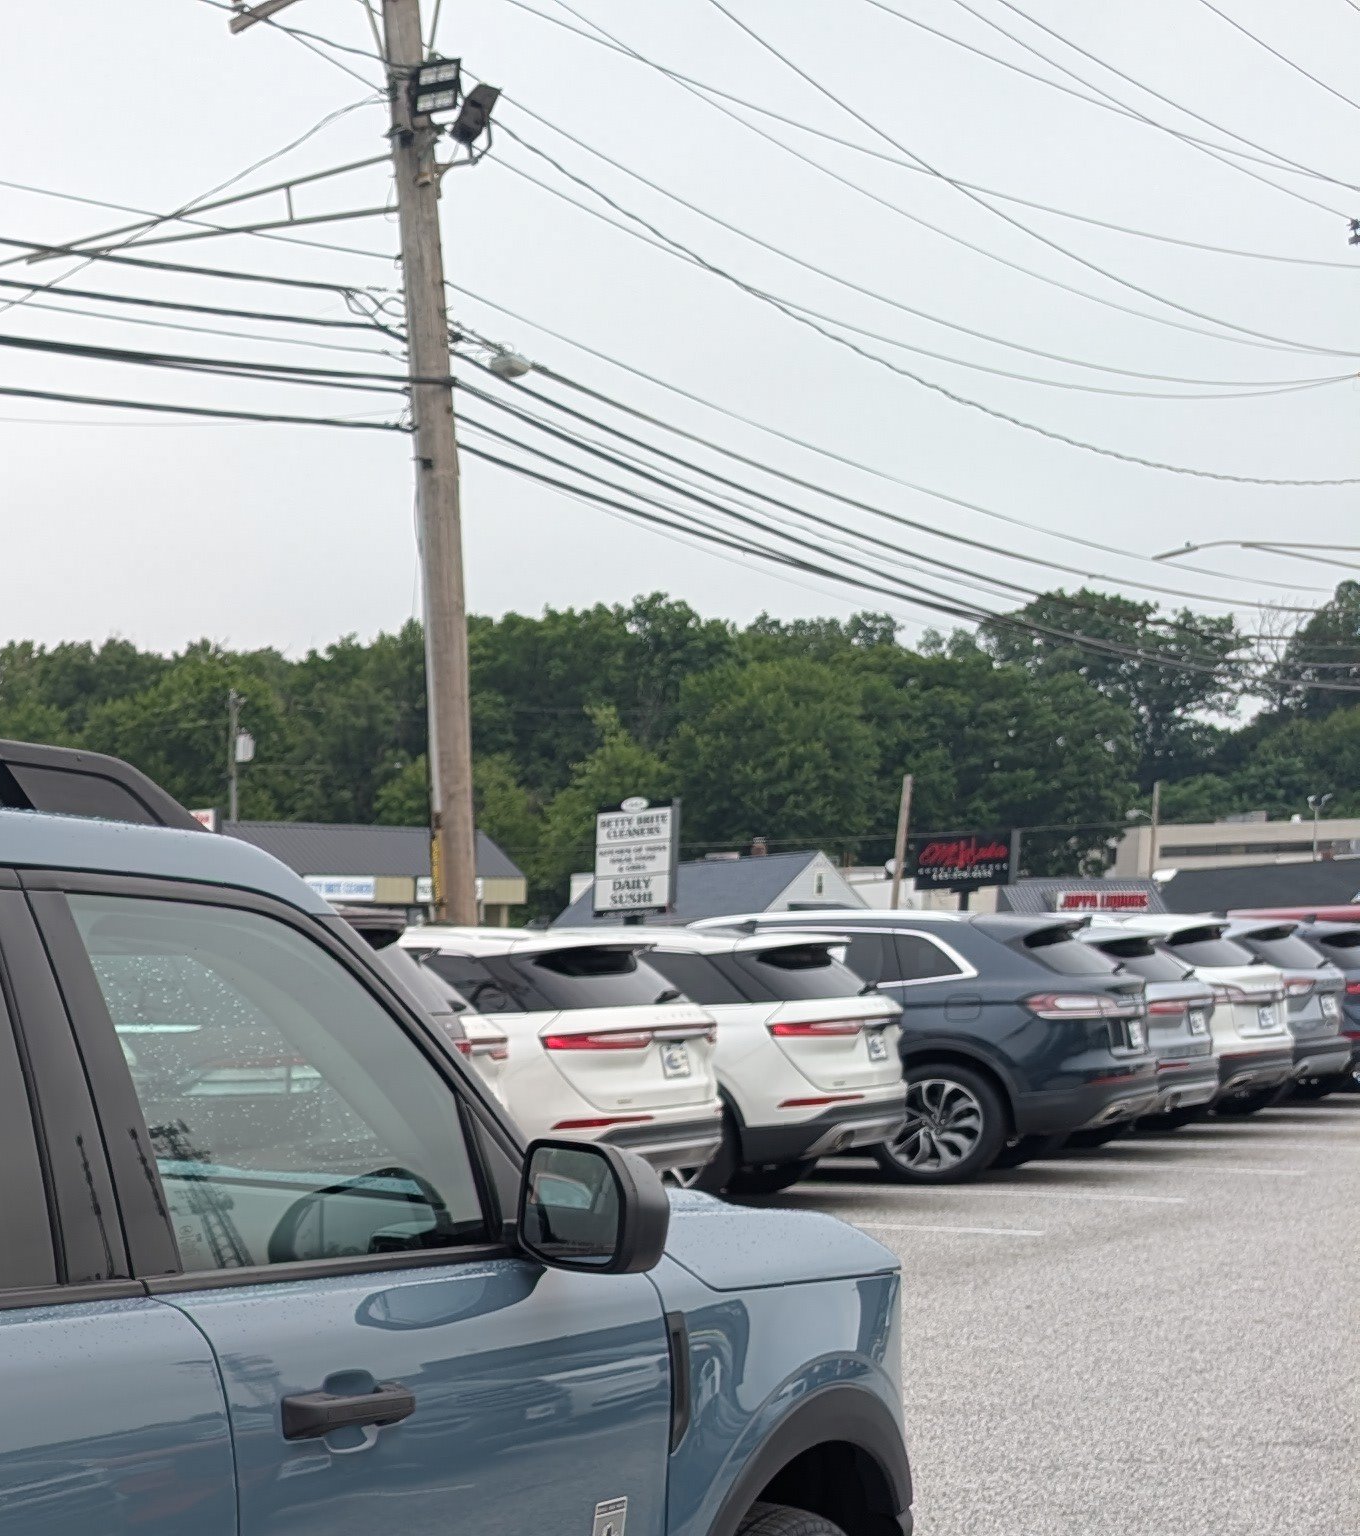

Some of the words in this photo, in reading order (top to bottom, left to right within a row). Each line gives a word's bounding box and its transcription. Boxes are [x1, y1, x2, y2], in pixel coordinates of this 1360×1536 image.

[600, 816, 633, 828] BETTY
[637, 814, 669, 826] BRITE
[606, 827, 661, 839] CLEANERS
[612, 878, 652, 891] DAILY
[610, 892, 653, 905] SUSHI
